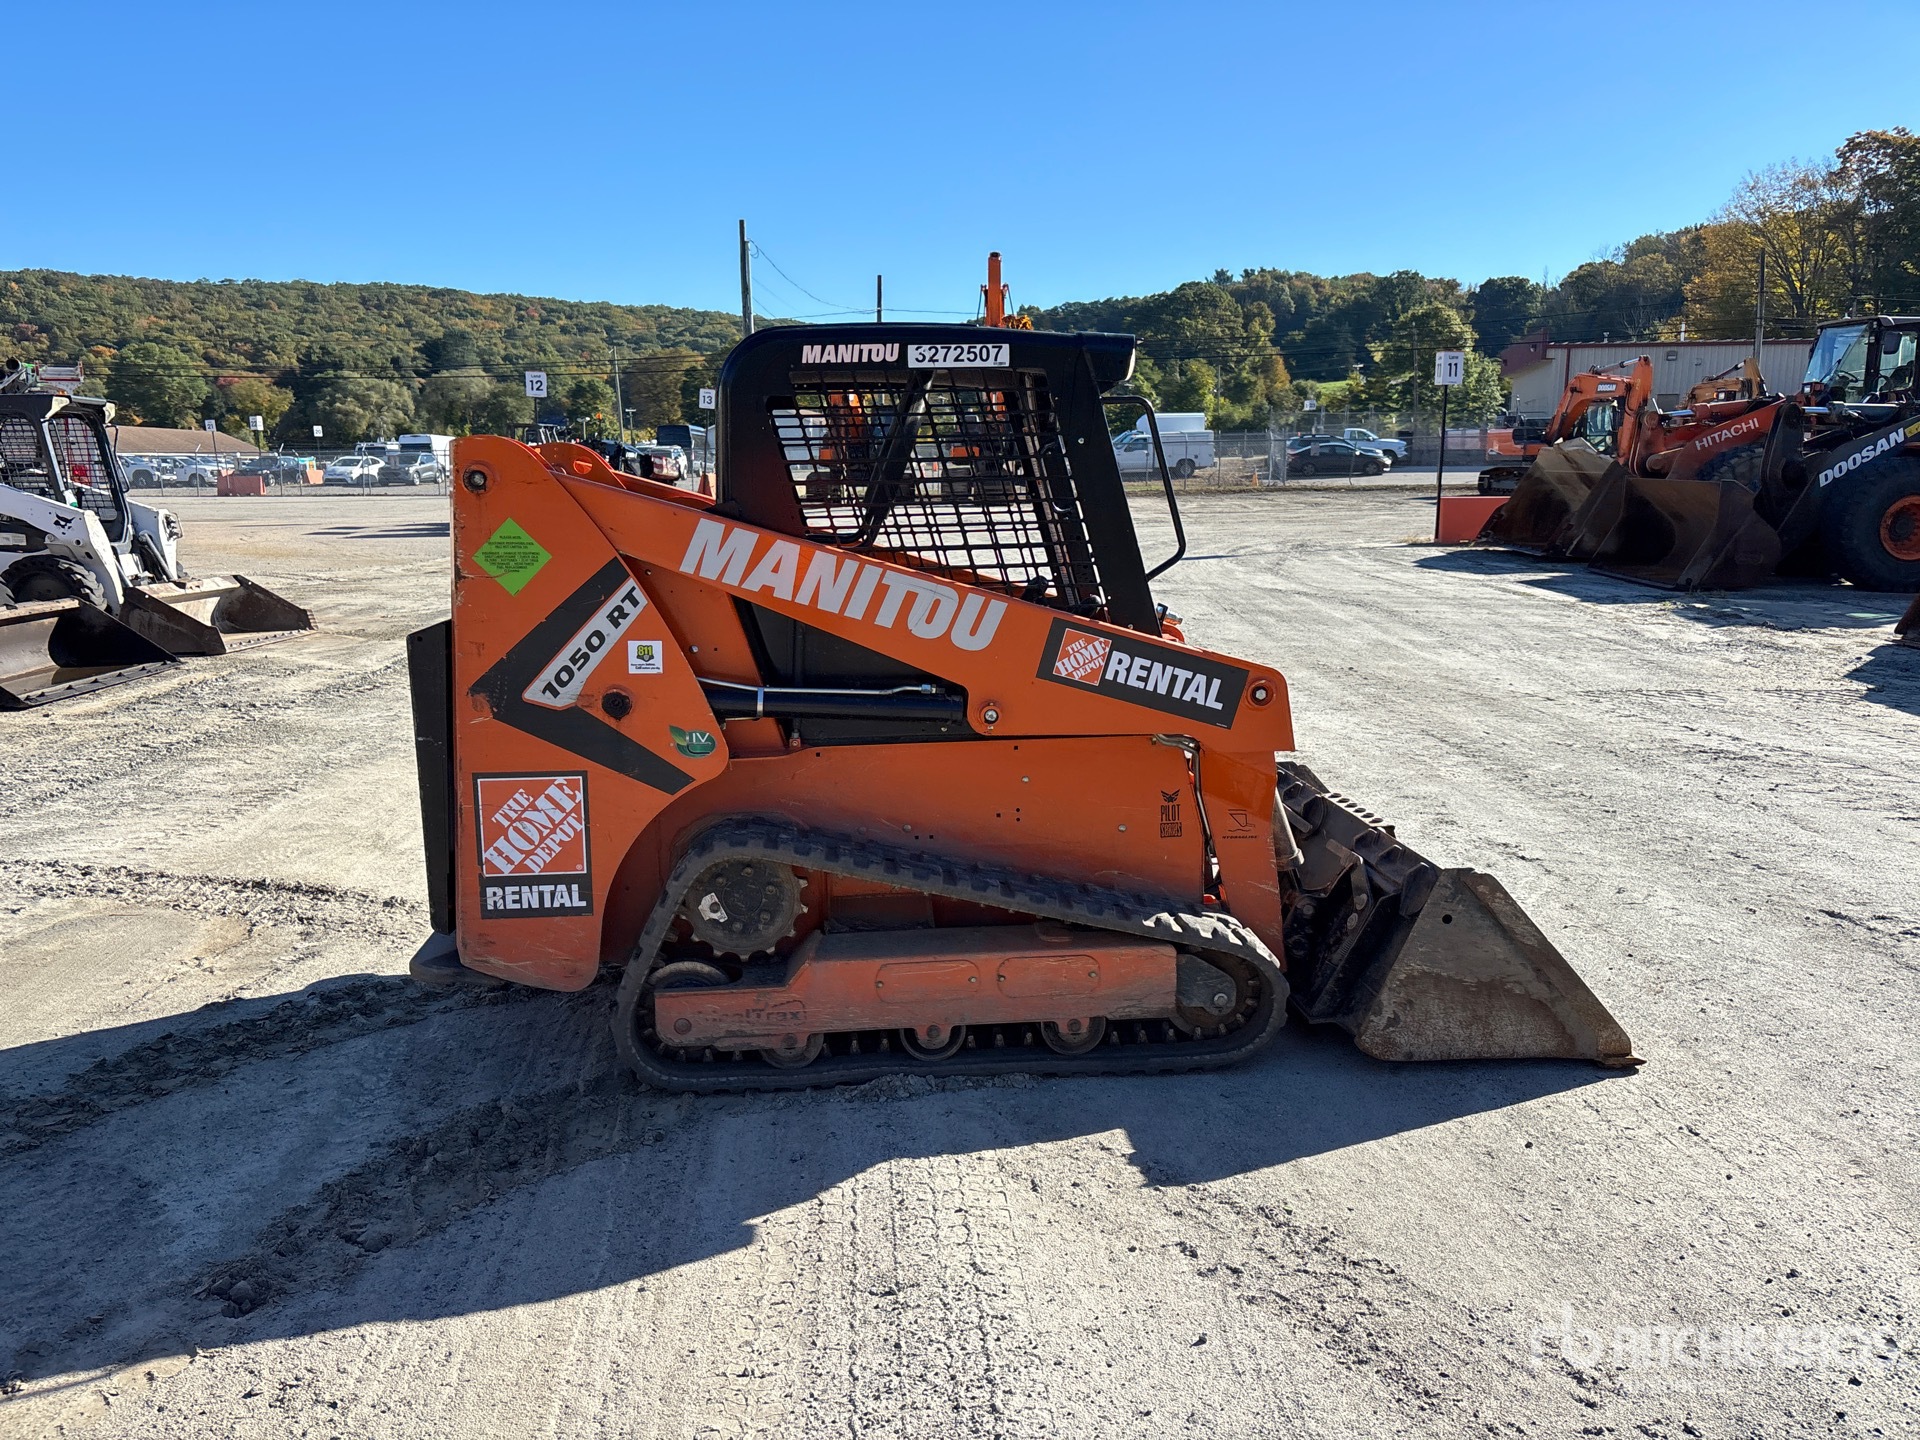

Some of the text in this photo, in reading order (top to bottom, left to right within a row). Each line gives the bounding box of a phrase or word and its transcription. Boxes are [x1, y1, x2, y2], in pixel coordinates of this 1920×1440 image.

[802, 343, 899, 363] MANITOU
[915, 345, 1003, 363] 3272507
[1447, 363, 1458, 377] 11
[529, 380, 544, 391] 12
[702, 395, 713, 405] 13
[1695, 417, 1760, 450] HITACHI
[1819, 427, 1905, 488] DOOSAN
[679, 517, 1008, 651] MANITOU
[541, 585, 640, 699] 1050 RT
[637, 645, 653, 656] 811
[1066, 638, 1087, 654] THE
[1056, 638, 1109, 676] HOME
[1073, 656, 1104, 680] DEPOT
[1105, 650, 1224, 711] RENTAL
[491, 788, 534, 828] THE
[1161, 804, 1181, 822] PILOT
[484, 778, 583, 875] HOME
[524, 813, 584, 873] DEPOT
[486, 884, 587, 910] RENTAL
